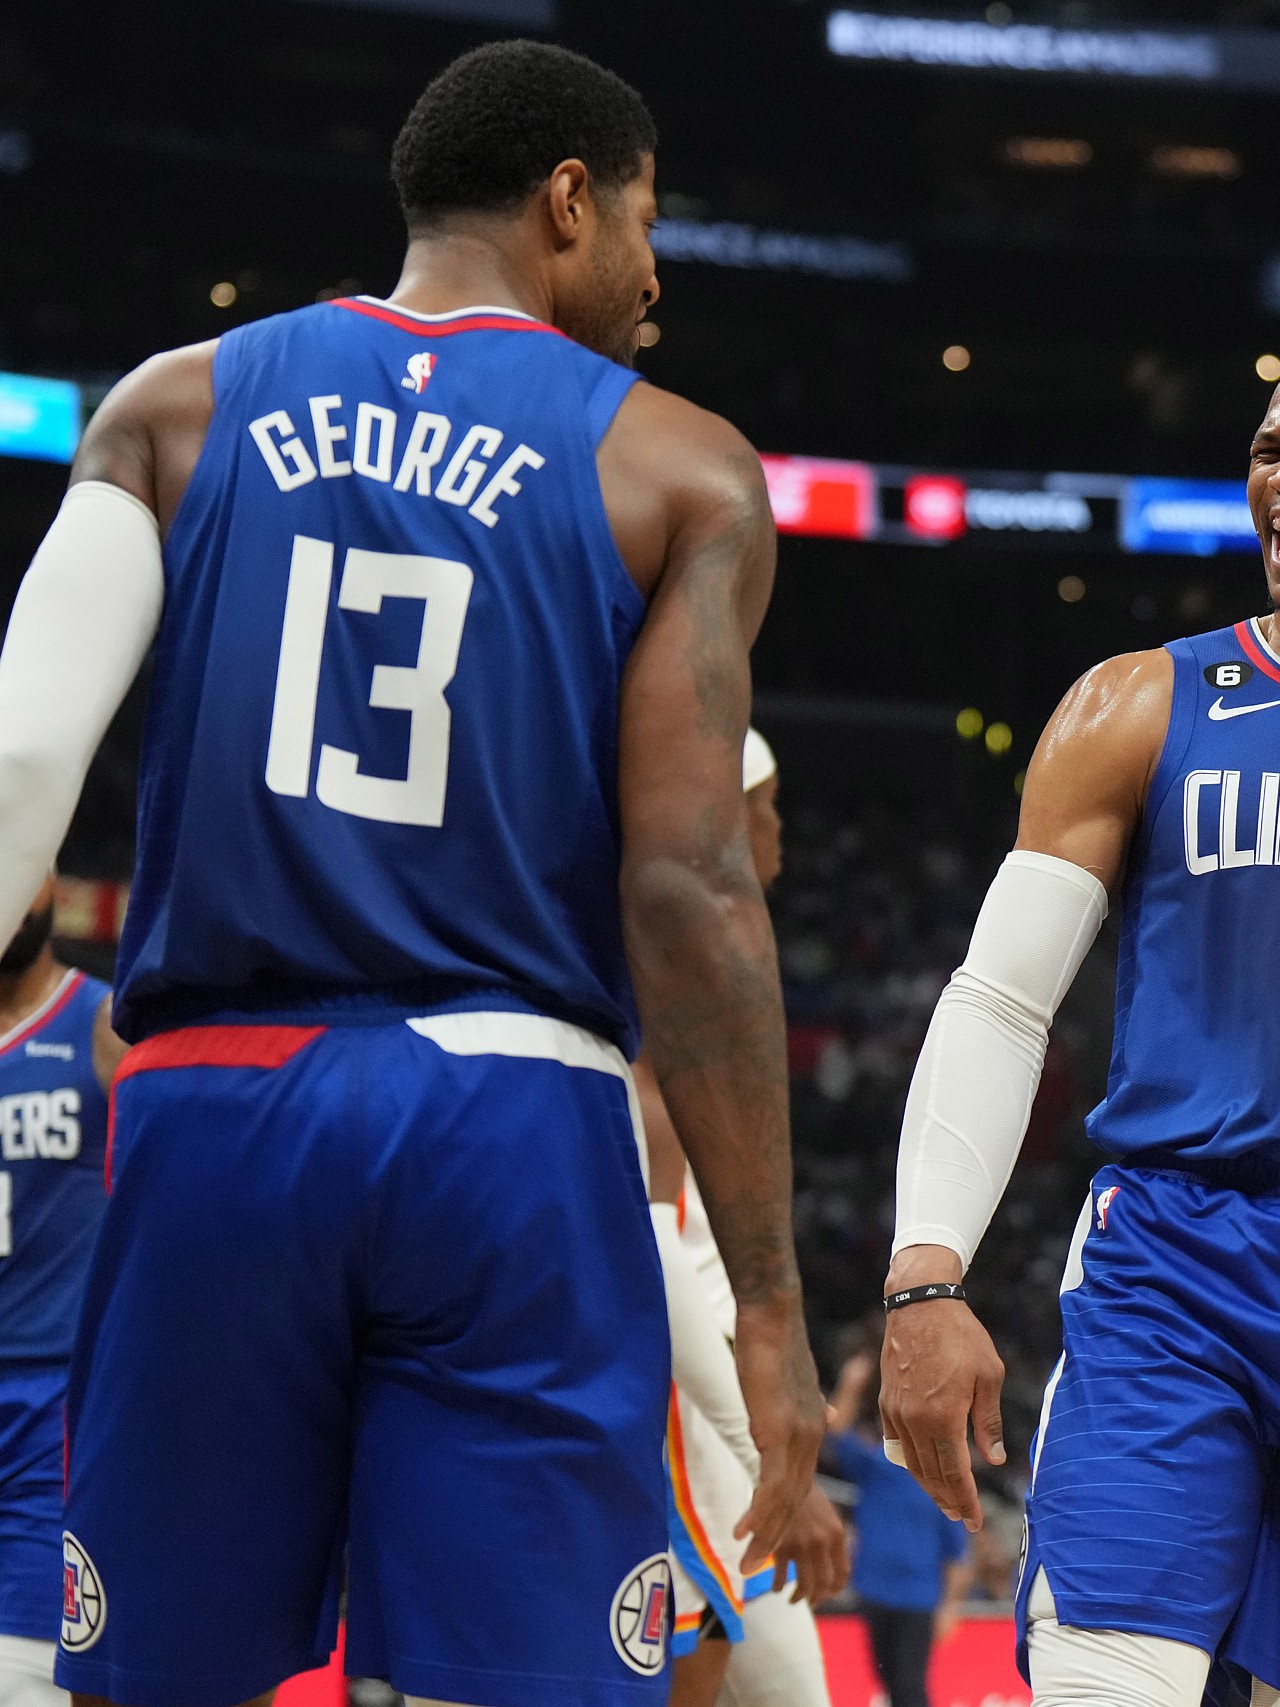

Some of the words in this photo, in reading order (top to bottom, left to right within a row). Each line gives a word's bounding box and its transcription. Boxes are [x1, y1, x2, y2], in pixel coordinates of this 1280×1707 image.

[248, 394, 545, 528] GEORGE
[265, 535, 474, 828] 13
[1215, 665, 1241, 686] 6
[0, 1088, 81, 1161] ERS
